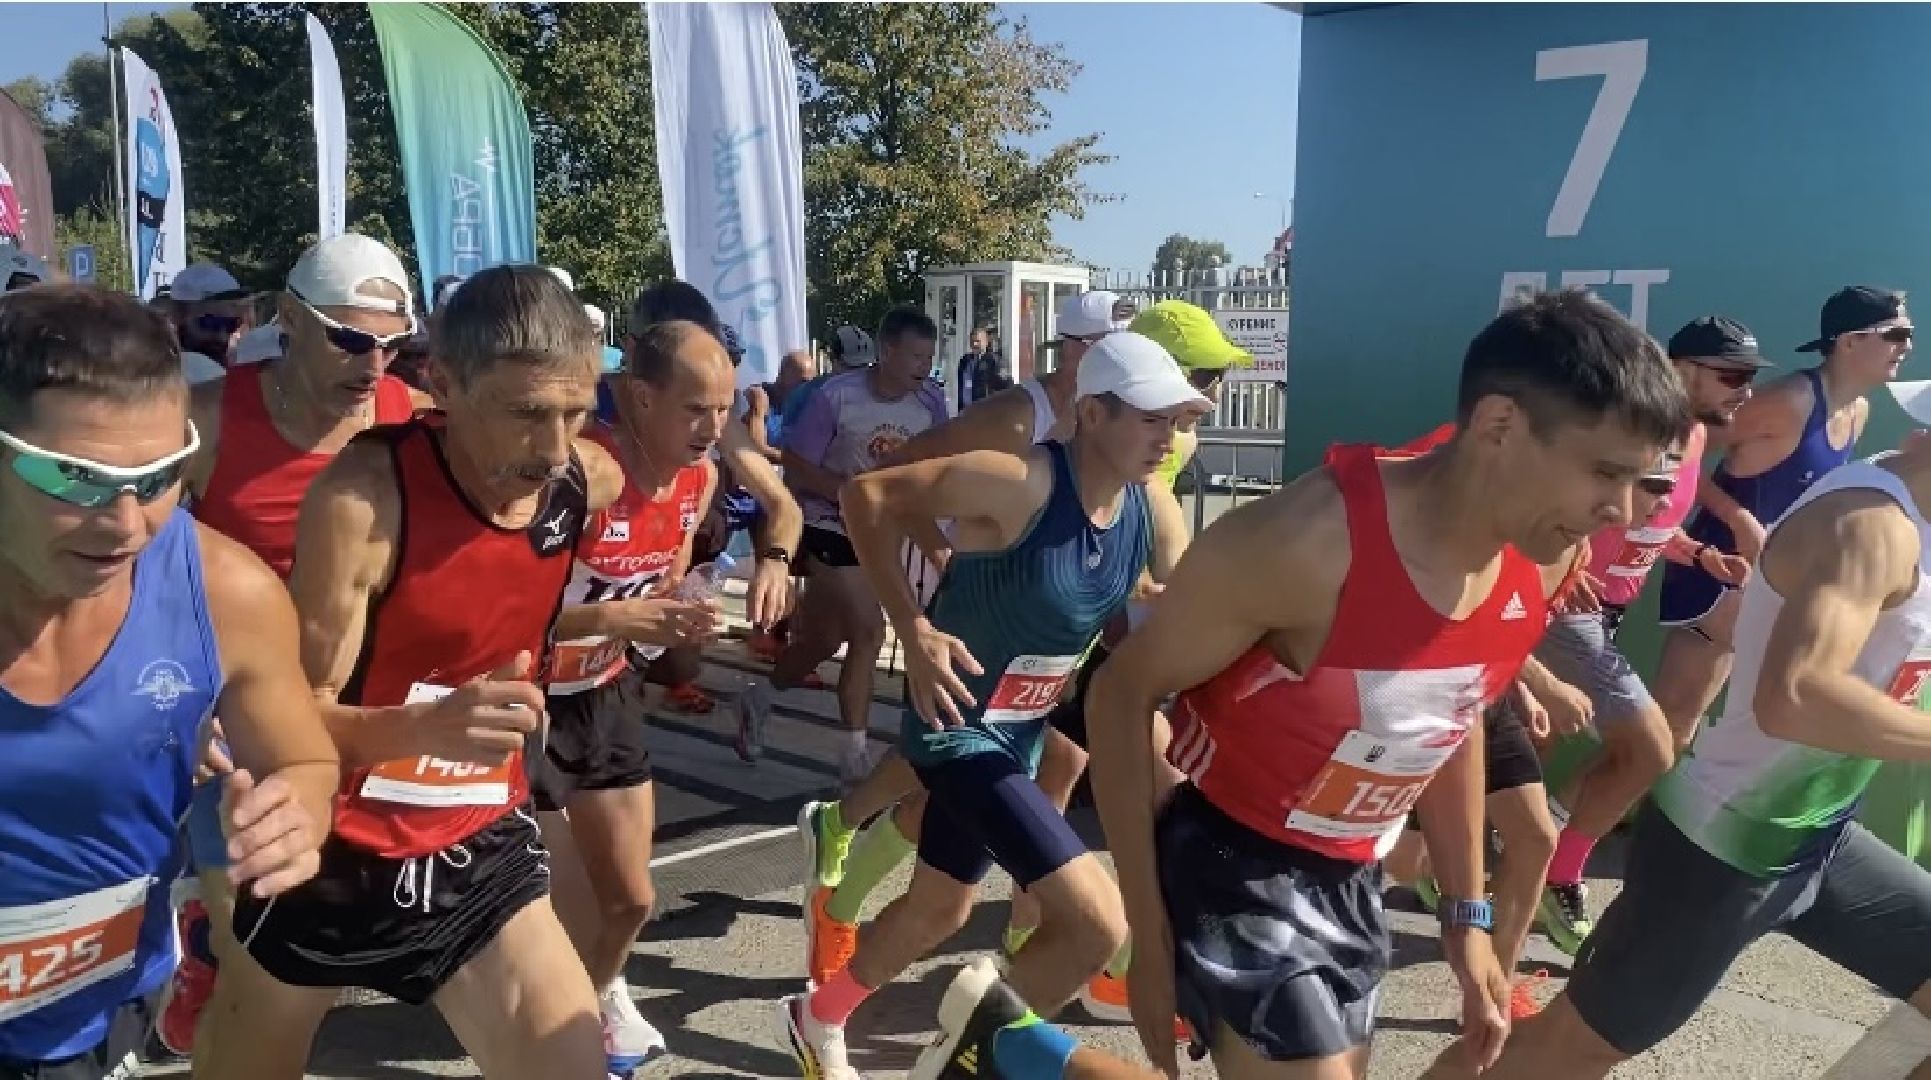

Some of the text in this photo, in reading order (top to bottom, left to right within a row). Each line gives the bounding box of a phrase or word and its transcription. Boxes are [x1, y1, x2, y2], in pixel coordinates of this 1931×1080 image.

[1536, 39, 1649, 238] 7
[1342, 781, 1430, 817] 150
[0, 930, 104, 992] 425
